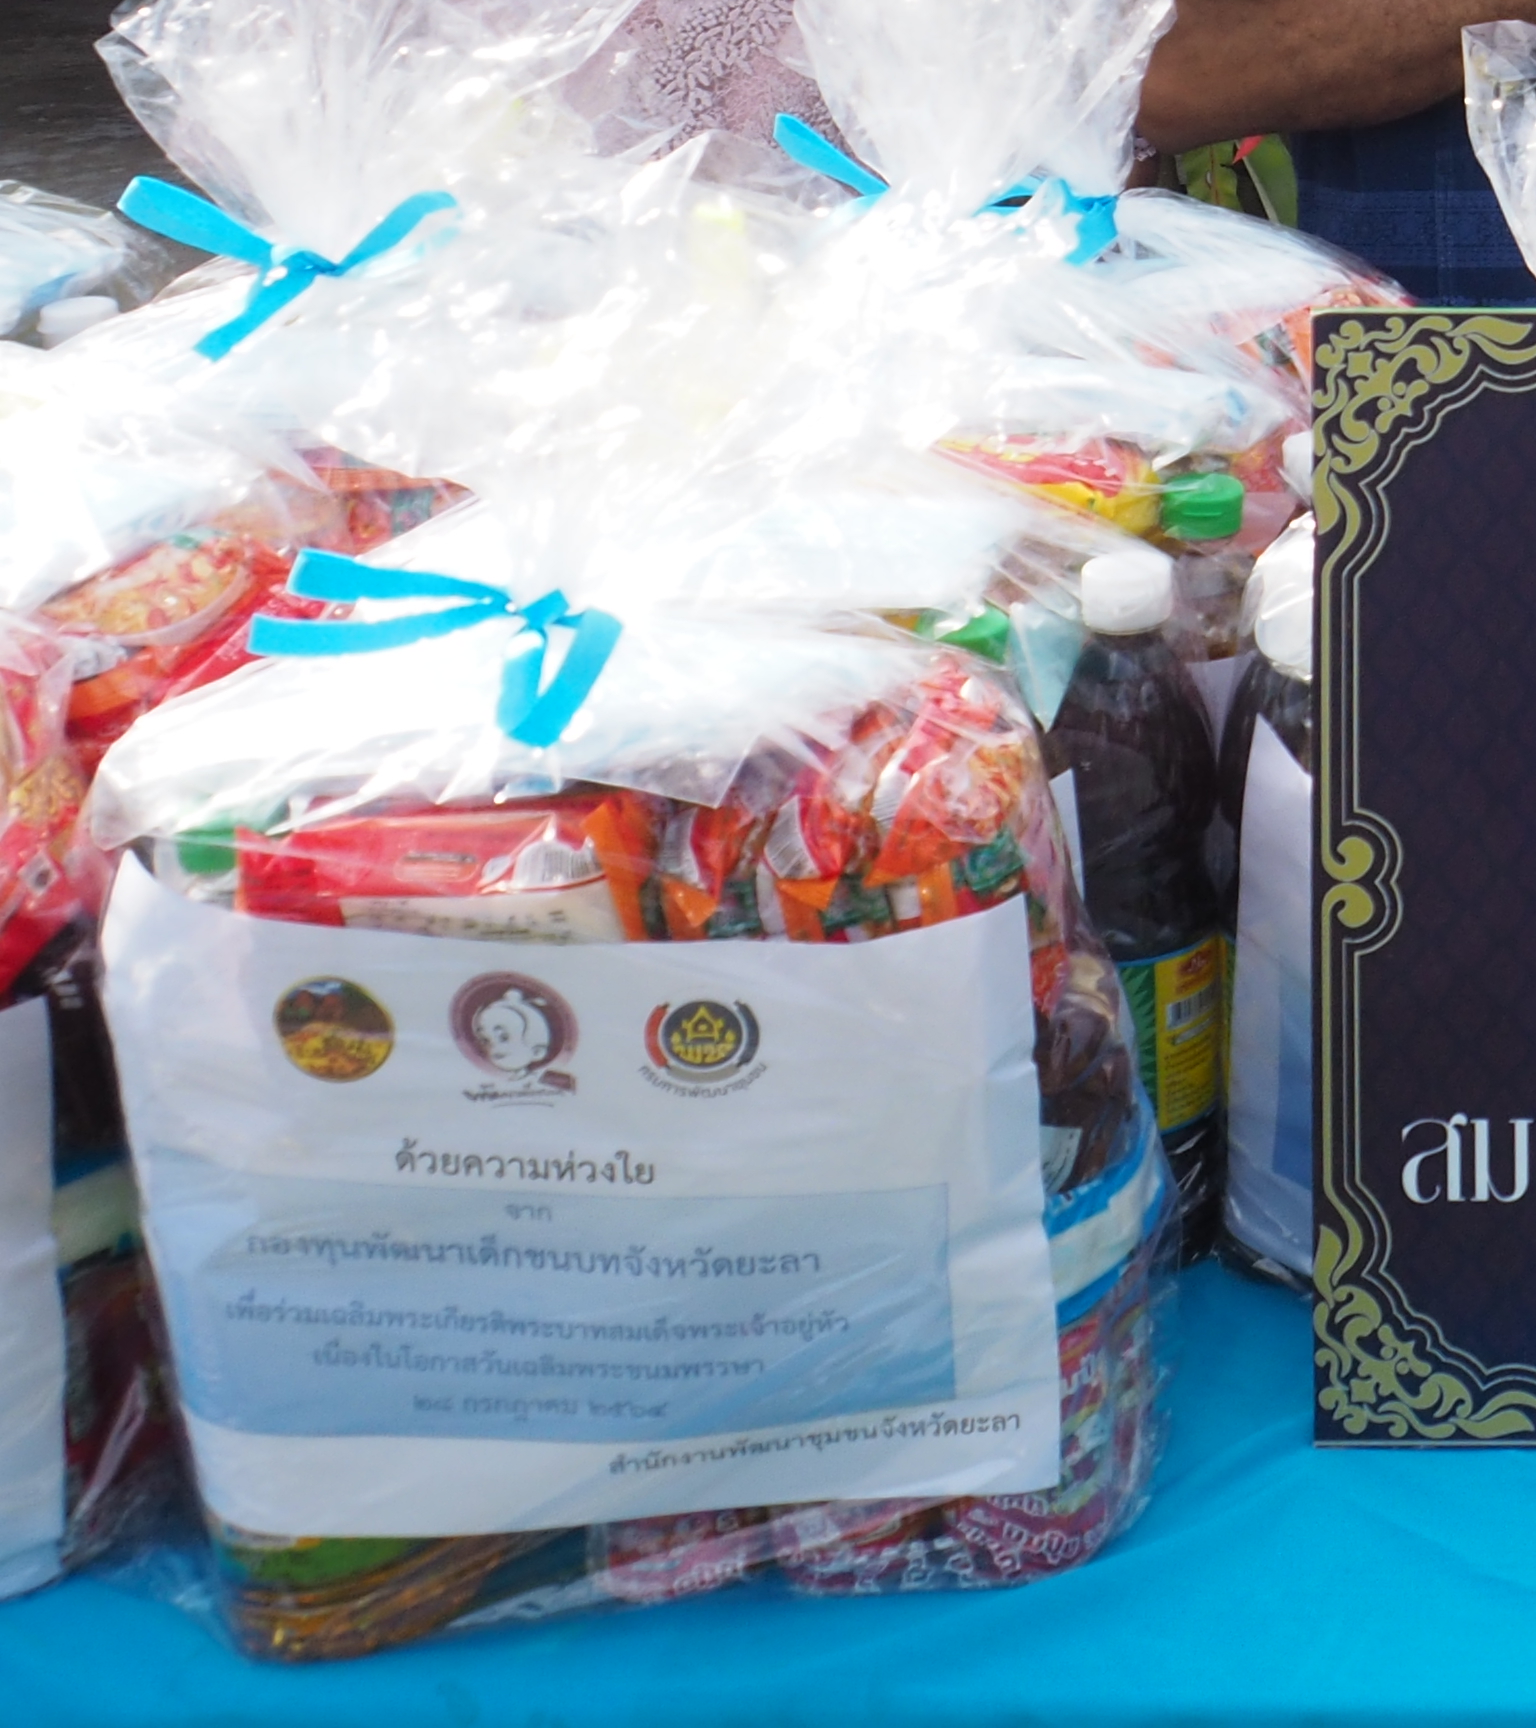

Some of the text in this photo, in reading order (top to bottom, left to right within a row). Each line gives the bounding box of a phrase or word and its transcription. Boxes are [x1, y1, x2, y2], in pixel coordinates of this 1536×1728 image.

[395, 1137, 656, 1186] ด้วยความห่วงใย
[504, 1202, 553, 1221] จาก
